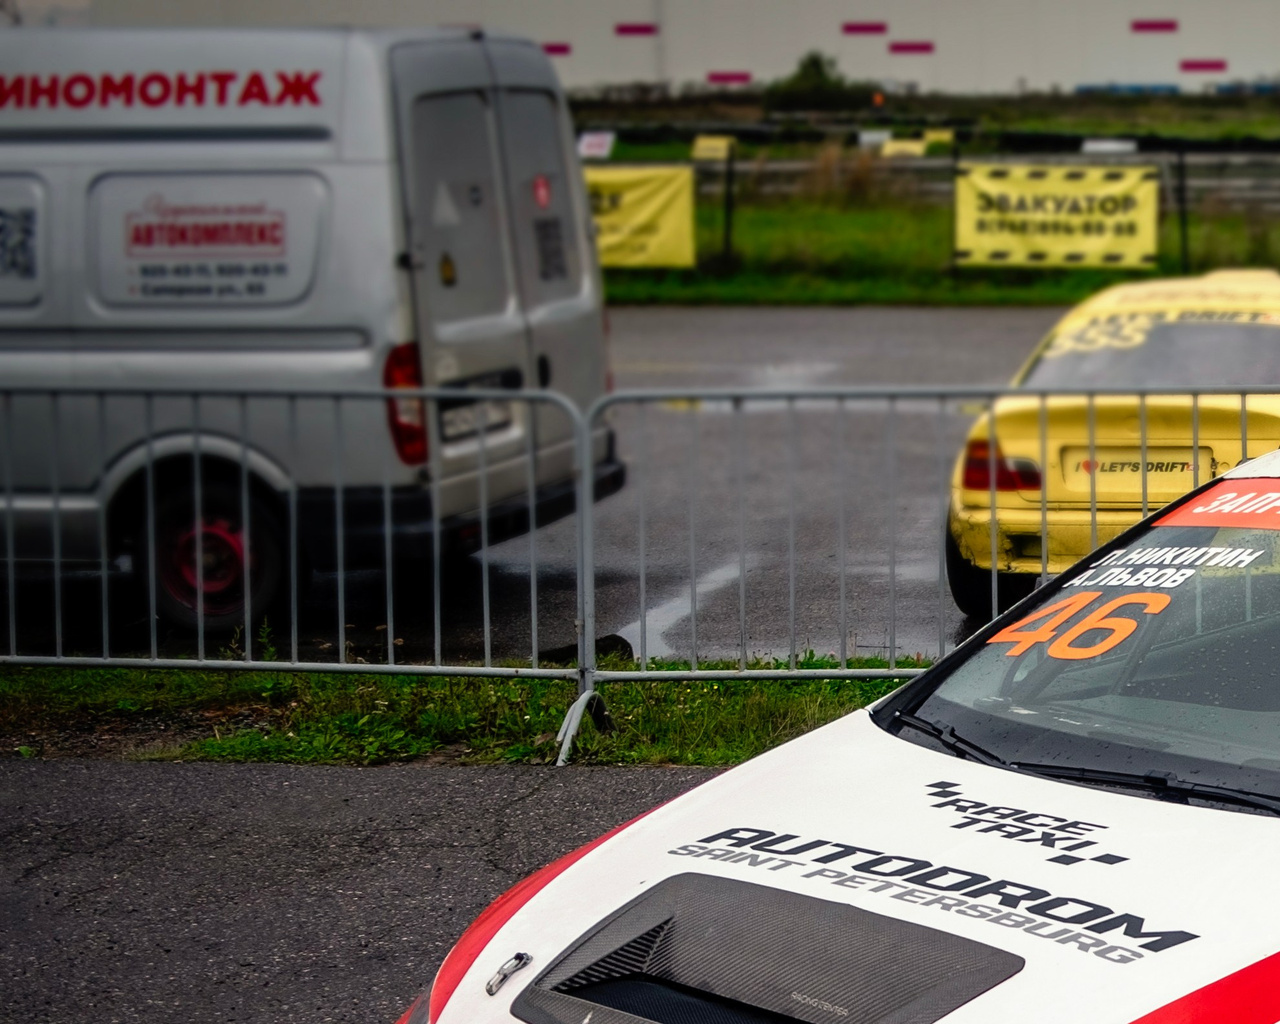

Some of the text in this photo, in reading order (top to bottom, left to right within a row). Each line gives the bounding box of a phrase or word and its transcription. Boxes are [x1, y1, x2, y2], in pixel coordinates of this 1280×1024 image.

[0, 71, 323, 109] ИНОМОНТАЖ
[977, 193, 1137, 216] ЭВАКУАТОР
[131, 222, 282, 246] АВТОКОМПЛЕКС
[1100, 462, 1140, 473] LET'S
[1062, 567, 1196, 588] А.ЛЬВОВ
[986, 591, 1171, 660] 46
[931, 798, 1109, 836] RACE
[950, 816, 1098, 852] TAXI
[668, 844, 1145, 964] SAINT PETERSBURG
[696, 827, 1201, 953] AUTODROM
